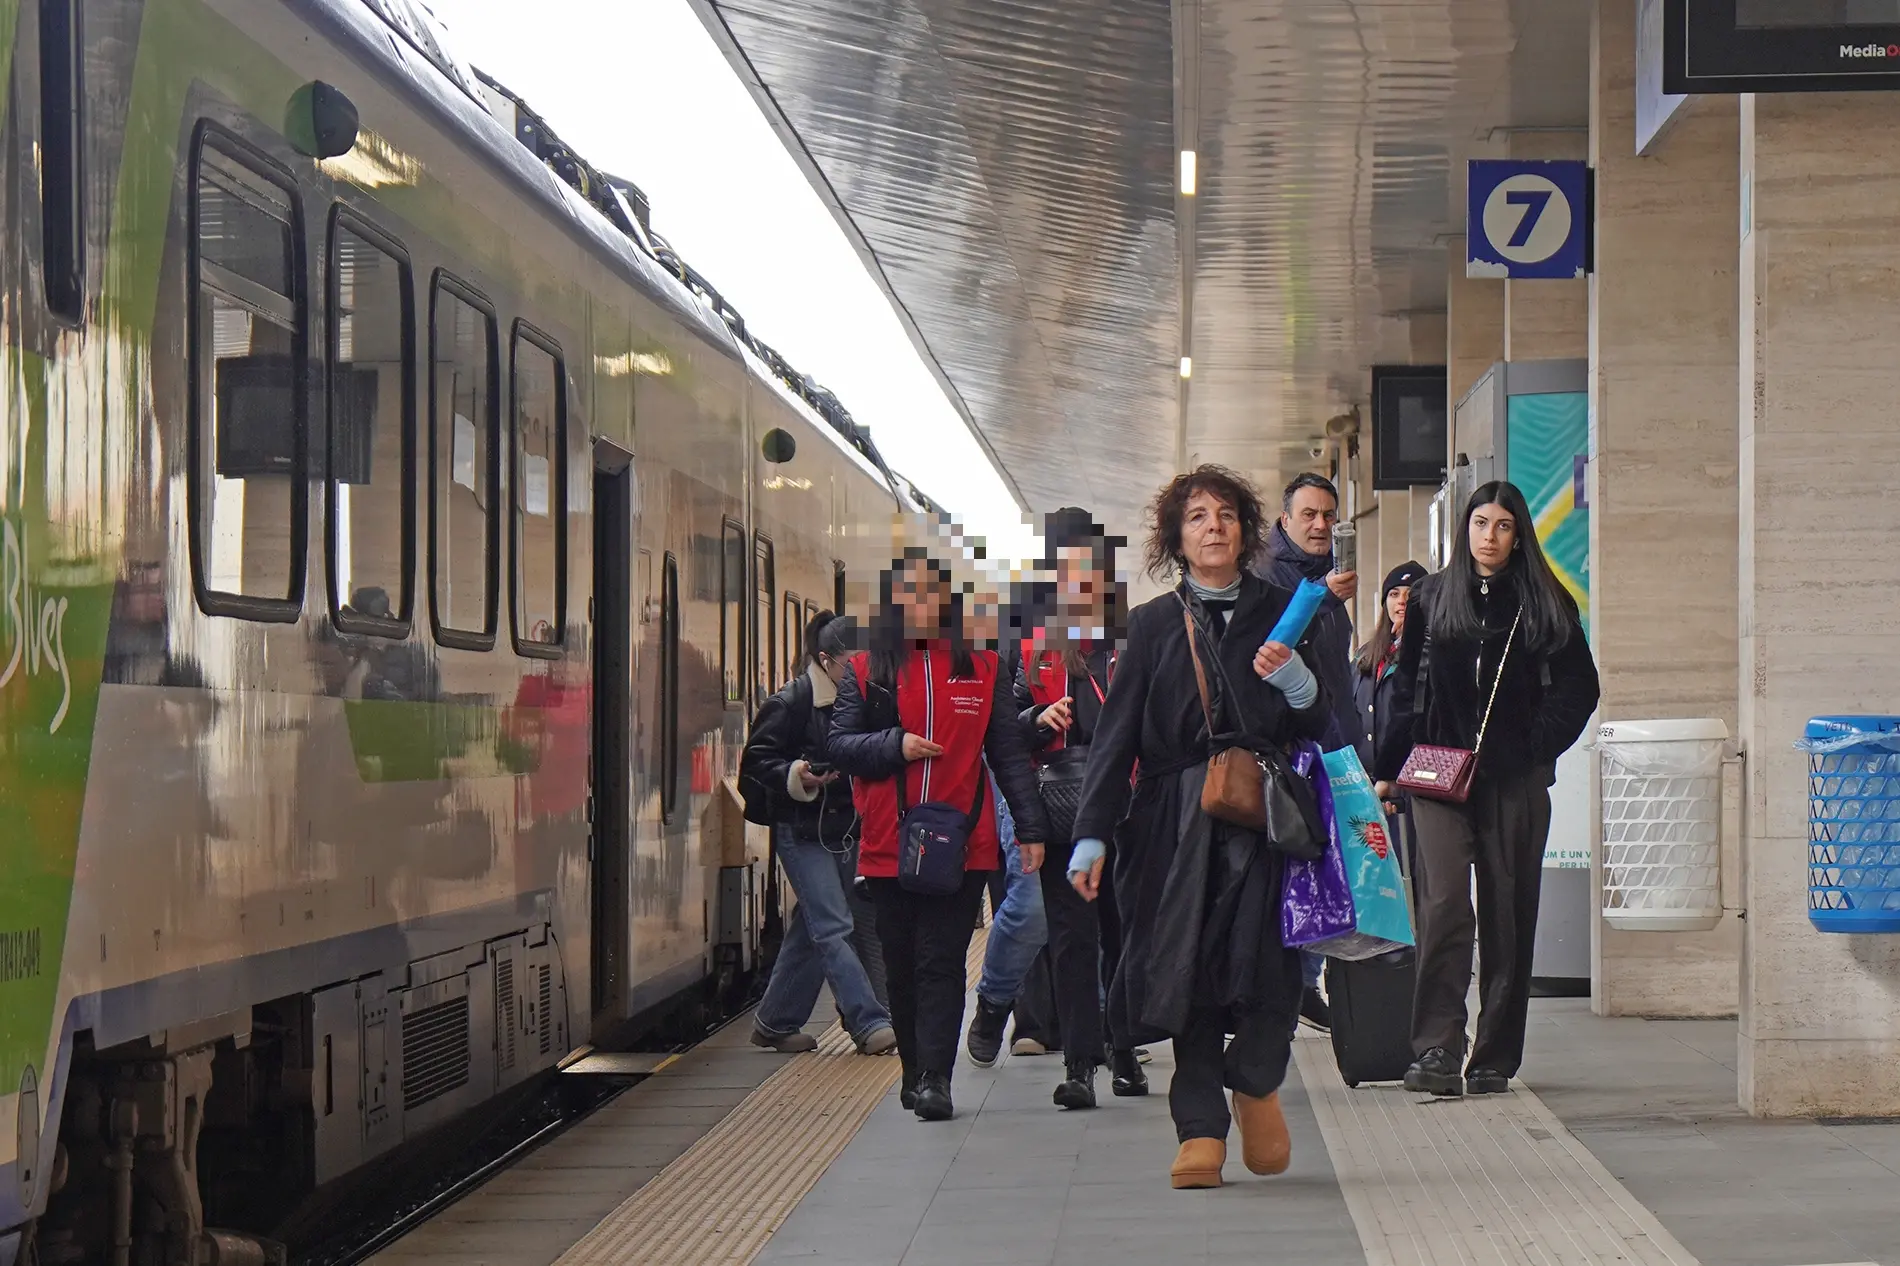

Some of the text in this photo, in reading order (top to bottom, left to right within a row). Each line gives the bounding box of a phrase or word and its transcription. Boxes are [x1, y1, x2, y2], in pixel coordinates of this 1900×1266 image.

[1839, 44, 1900, 58] MediaO
[1506, 190, 1553, 247] 7
[0, 516, 71, 735] Blues
[1570, 851, 1583, 859] UN
[1559, 861, 1577, 869] PER
